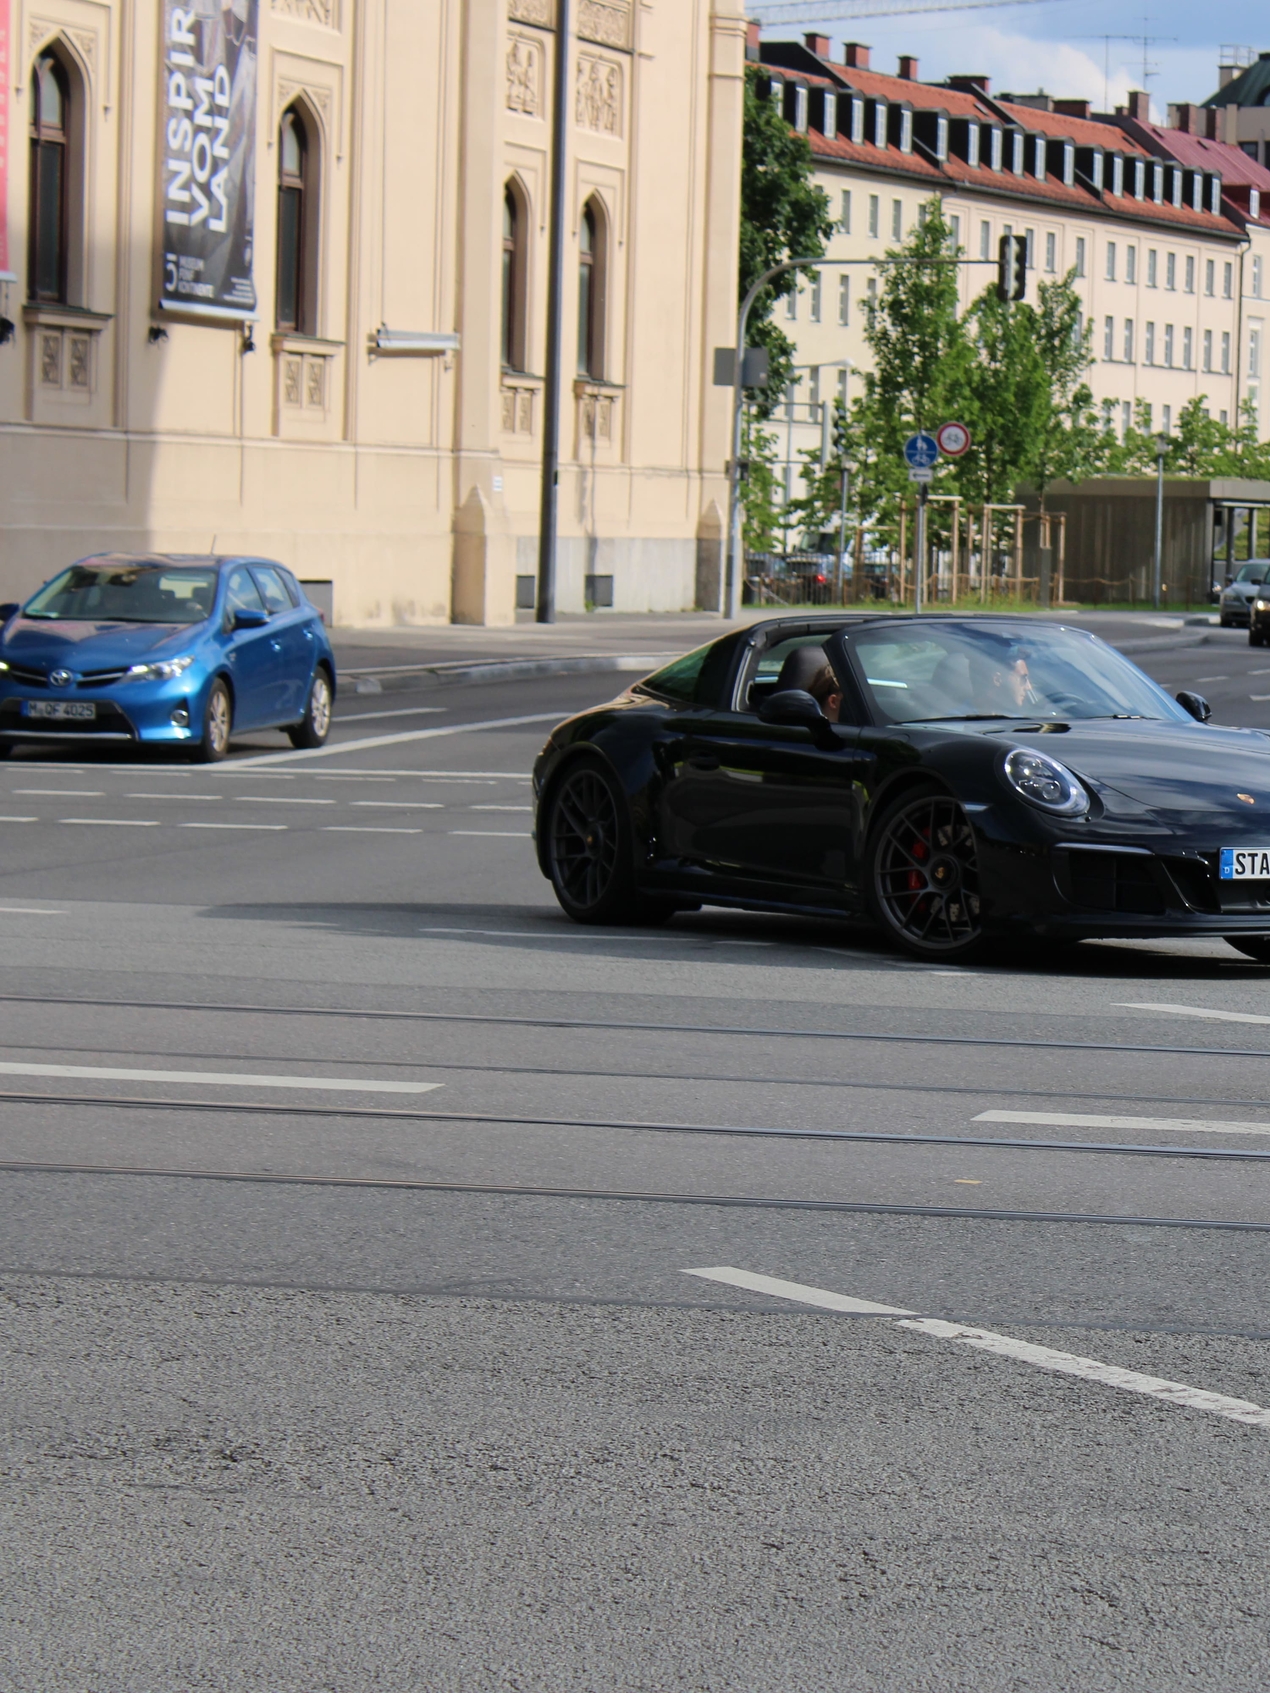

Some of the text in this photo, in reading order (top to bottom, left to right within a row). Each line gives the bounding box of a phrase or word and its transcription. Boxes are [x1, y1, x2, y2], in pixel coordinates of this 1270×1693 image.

[190, 76, 213, 227] VOM
[208, 65, 231, 233] LAND
[1235, 853, 1270, 875] STA
